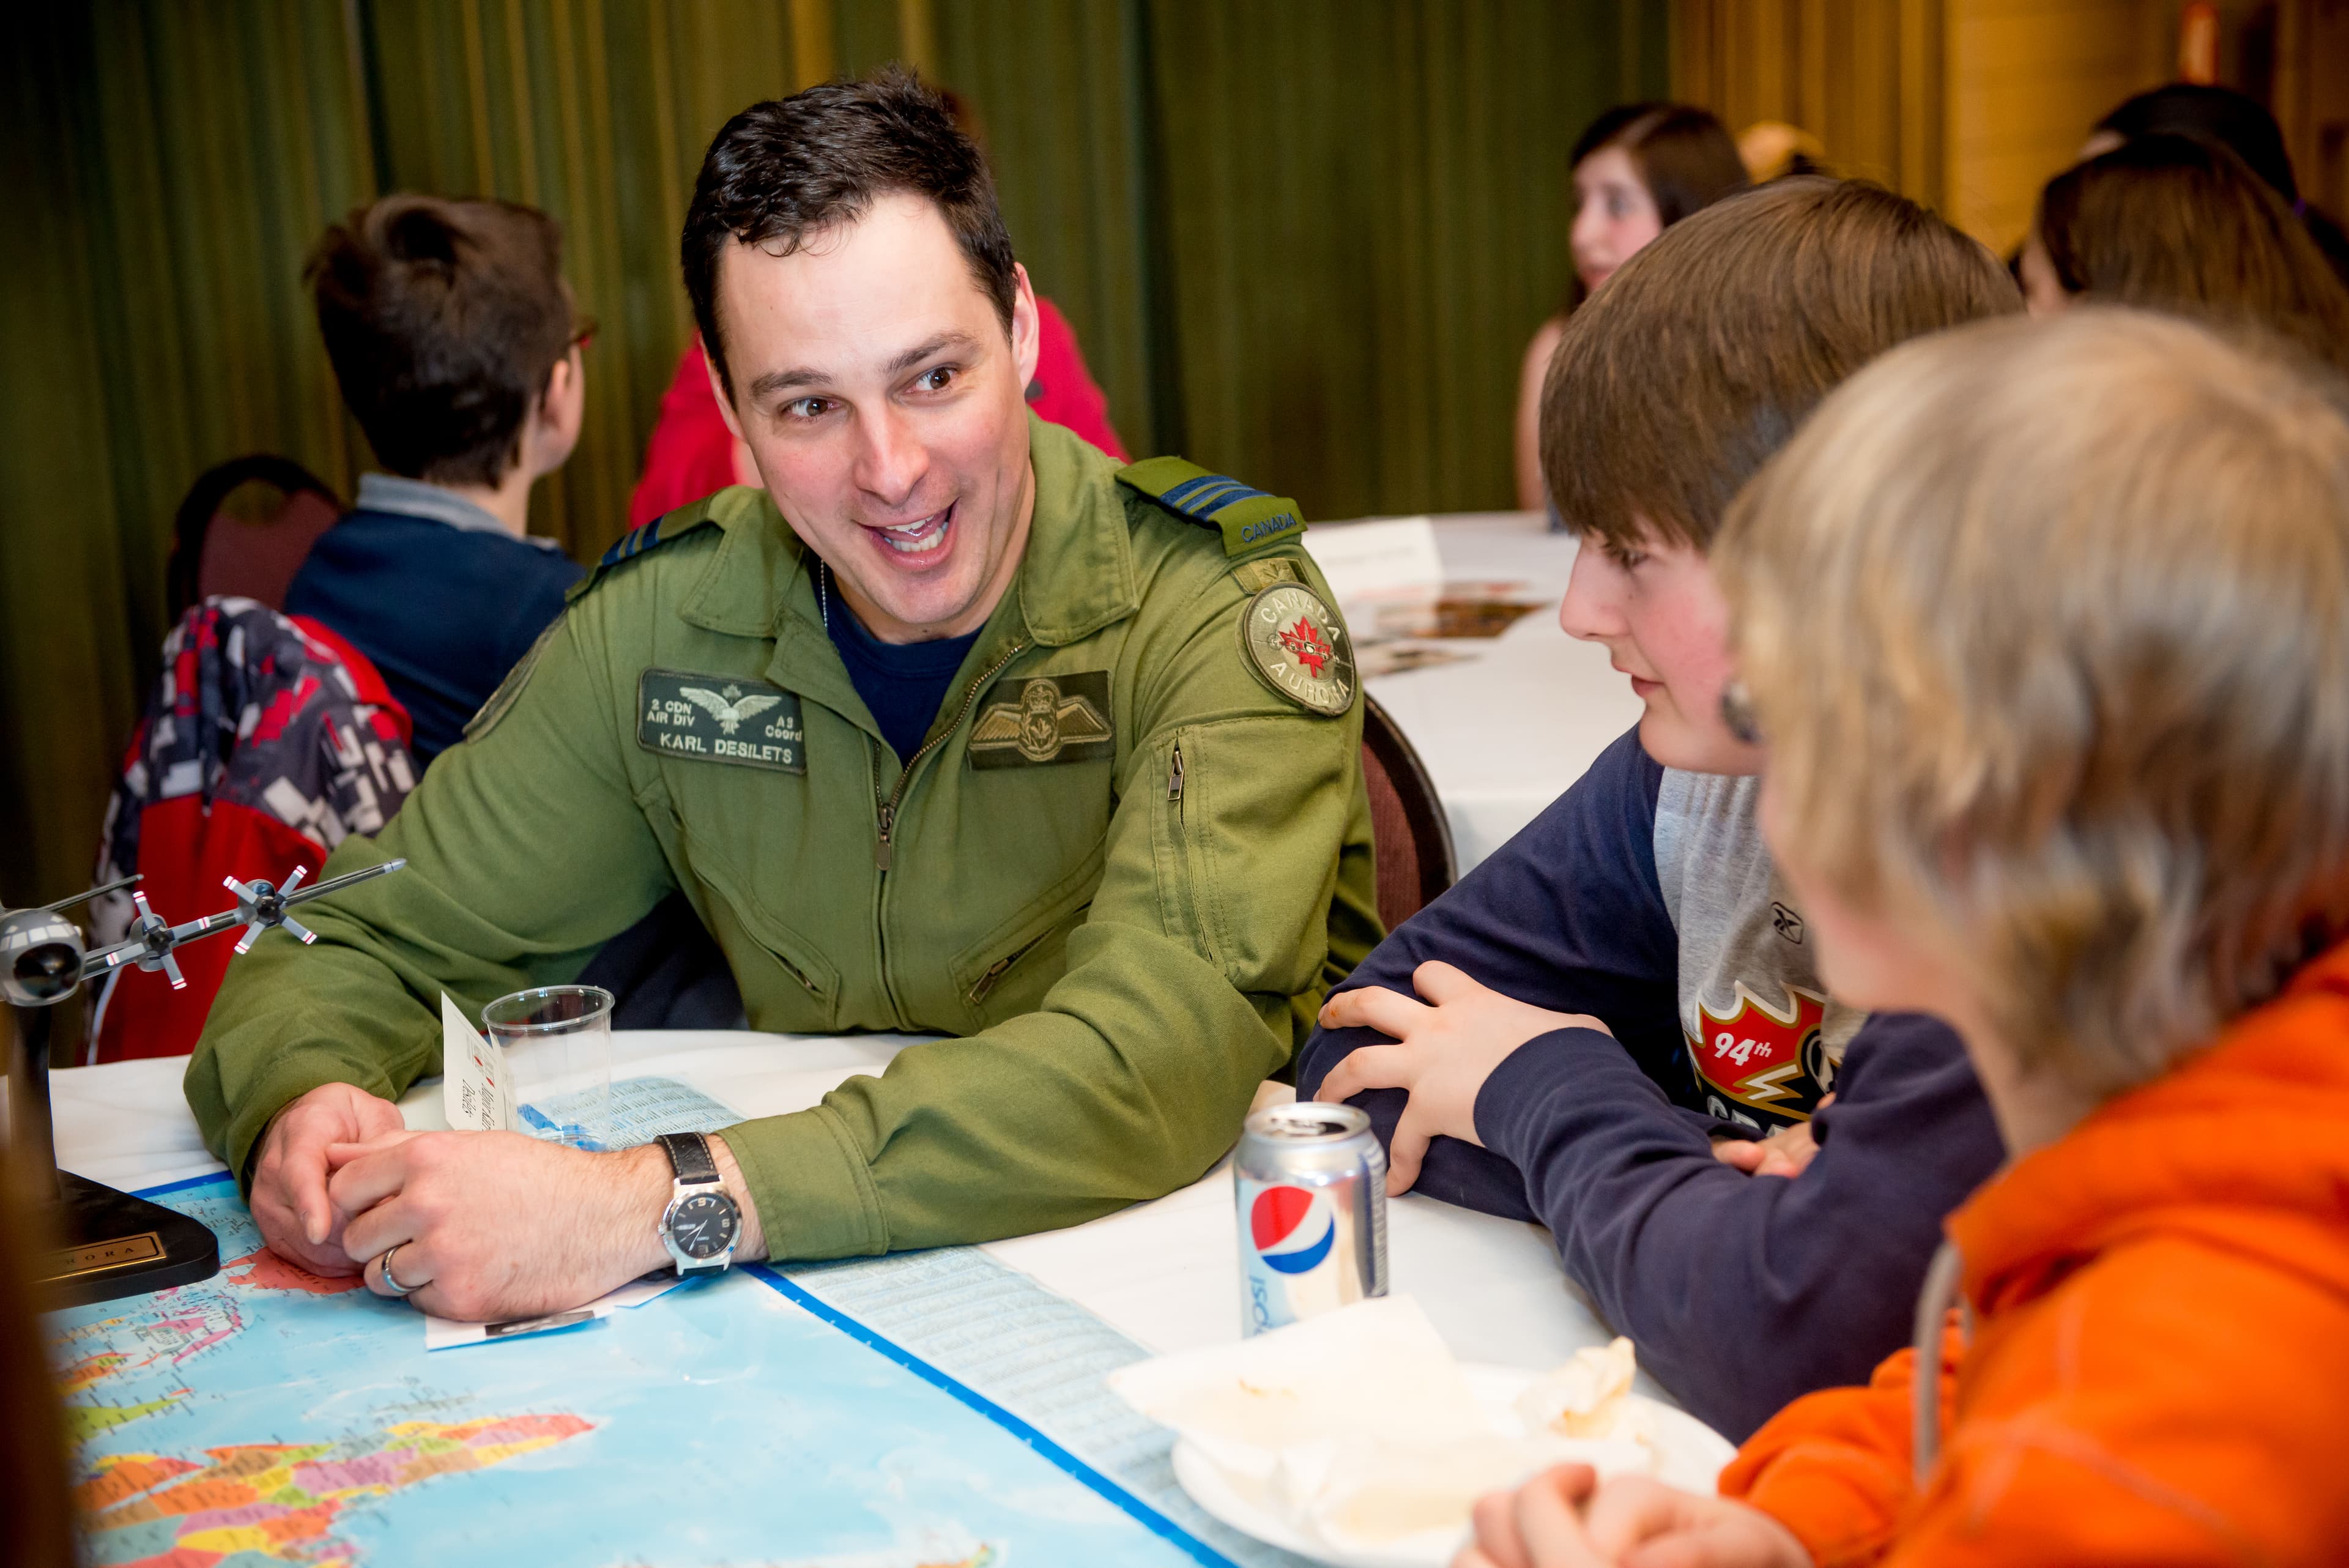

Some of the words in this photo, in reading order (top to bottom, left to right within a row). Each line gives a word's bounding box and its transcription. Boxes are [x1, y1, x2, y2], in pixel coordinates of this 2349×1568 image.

[1241, 513, 1297, 543] CANADA
[1261, 592, 1341, 641] CANADA
[1270, 662, 1349, 705] AURORA
[647, 710, 668, 724] AIR
[673, 713, 696, 727] DIV
[651, 699, 659, 711] 2
[665, 700, 692, 713] CDN
[765, 724, 802, 741] Coord
[659, 732, 707, 753] KARL
[714, 738, 793, 765] DESILETS
[1714, 1032, 1773, 1067] 94th
